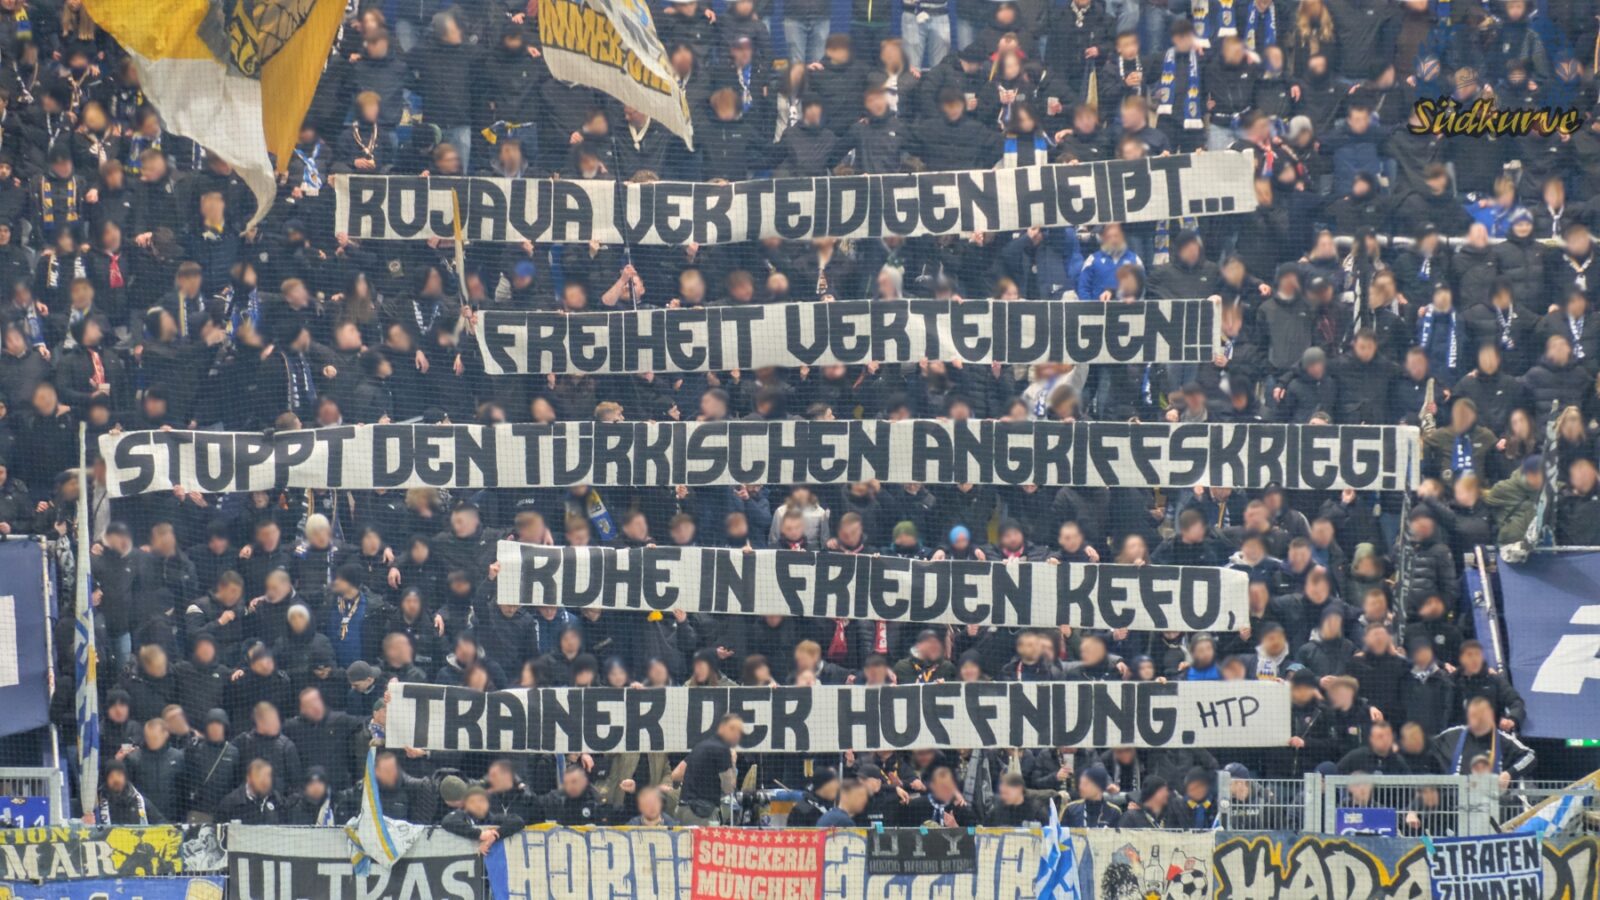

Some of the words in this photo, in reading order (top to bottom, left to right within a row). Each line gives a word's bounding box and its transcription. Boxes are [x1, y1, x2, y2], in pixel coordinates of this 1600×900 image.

[348, 176, 593, 242] ROJAVA
[613, 171, 1000, 244] VERTEIDIGEN
[484, 306, 764, 373] FREIHEIT
[786, 300, 1213, 364] VERTEIDIGEN!!
[114, 425, 355, 496] STOPPT
[373, 424, 498, 487] DEN
[512, 420, 890, 485] TÜRKISCHEN
[912, 420, 1397, 489] ANGRIFFSKRIEG!
[520, 545, 681, 609] RUHE
[699, 548, 756, 612] IN
[776, 551, 1032, 625] FRIEDEN
[1057, 562, 1235, 630] KEFO,
[402, 684, 666, 751] TRAINER
[687, 686, 812, 750] DER
[838, 682, 1195, 749] HOFFNUNG.
[1196, 696, 1259, 728] HTP
[3, 842, 118, 879] MAR
[699, 839, 817, 872] SCHICKERIA
[1433, 839, 1539, 877] STRAFEN
[238, 858, 475, 900] ULTRAS
[696, 867, 816, 900] MÜNCHEN
[1440, 876, 1538, 900] ZÜNDEN
